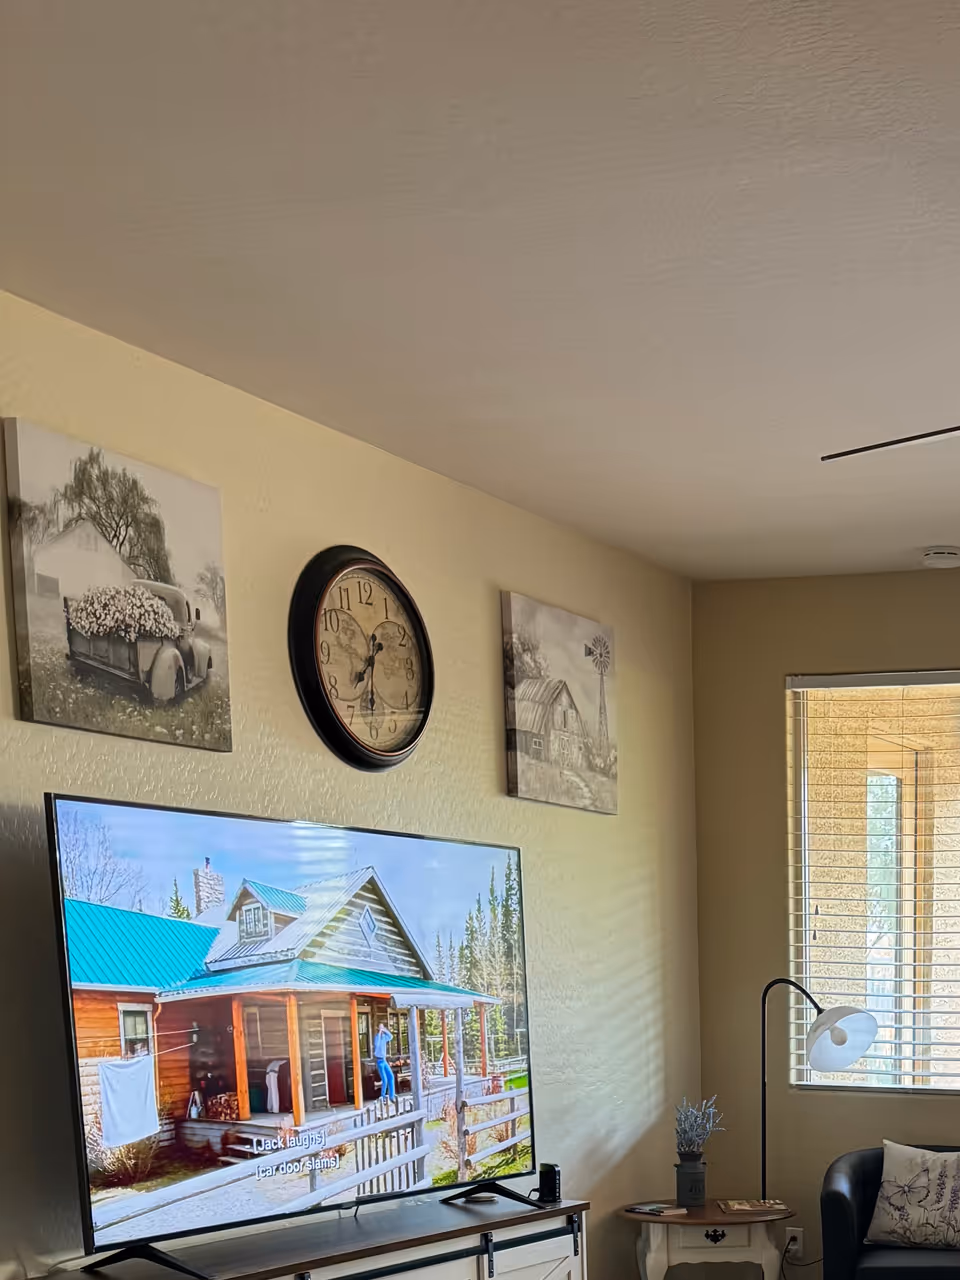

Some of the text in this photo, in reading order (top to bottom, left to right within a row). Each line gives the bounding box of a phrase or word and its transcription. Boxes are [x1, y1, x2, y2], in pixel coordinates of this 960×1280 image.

[338, 586, 352, 611] 11
[357, 580, 373, 606] 12
[323, 608, 340, 633] 10
[398, 624, 407, 648] 2
[320, 640, 331, 665] 9
[405, 657, 415, 681] 3
[329, 675, 339, 700] 8
[401, 690, 410, 711] 4
[346, 704, 355, 727] 7
[388, 711, 397, 734] 5
[369, 719, 379, 740] 6
[279, 1161, 305, 1175] door
[306, 1154, 340, 1171] slams]
